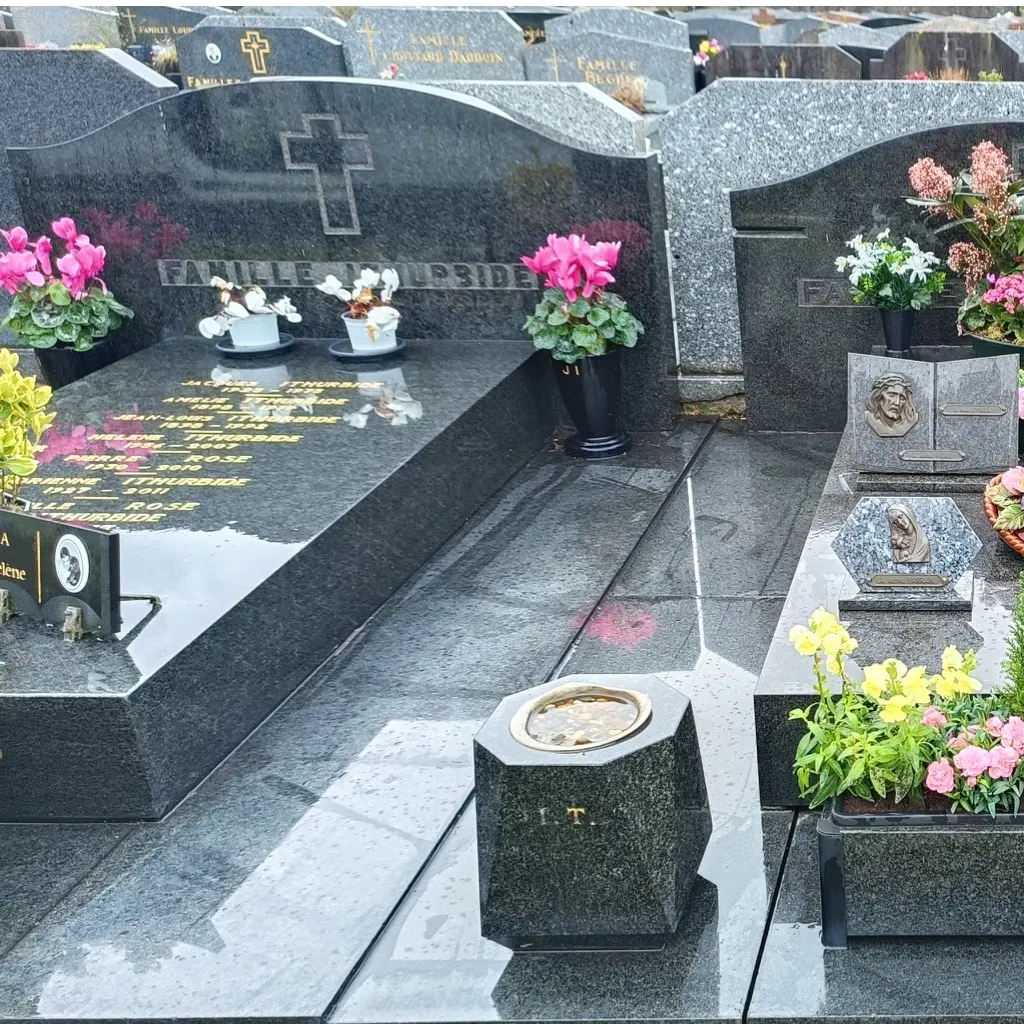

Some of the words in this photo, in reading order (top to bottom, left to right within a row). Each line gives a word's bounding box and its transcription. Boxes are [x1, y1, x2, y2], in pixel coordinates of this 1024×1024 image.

[139, 26, 170, 34] FAMILLE
[577, 56, 638, 72] FAMILLE
[164, 261, 314, 285] FAMILLE
[181, 380, 259, 388] JACQUES
[279, 381, 385, 389] ITHURBIDE
[227, 416, 341, 424] ITHURBIDE
[183, 434, 304, 442] ITHURBIDE
[183, 455, 253, 463] ROSE
[121, 477, 251, 487] ITHURBIDE
[124, 502, 200, 511] ROSE
[41, 513, 167, 522] THURBIDE
[0, 532, 10, 547] A
